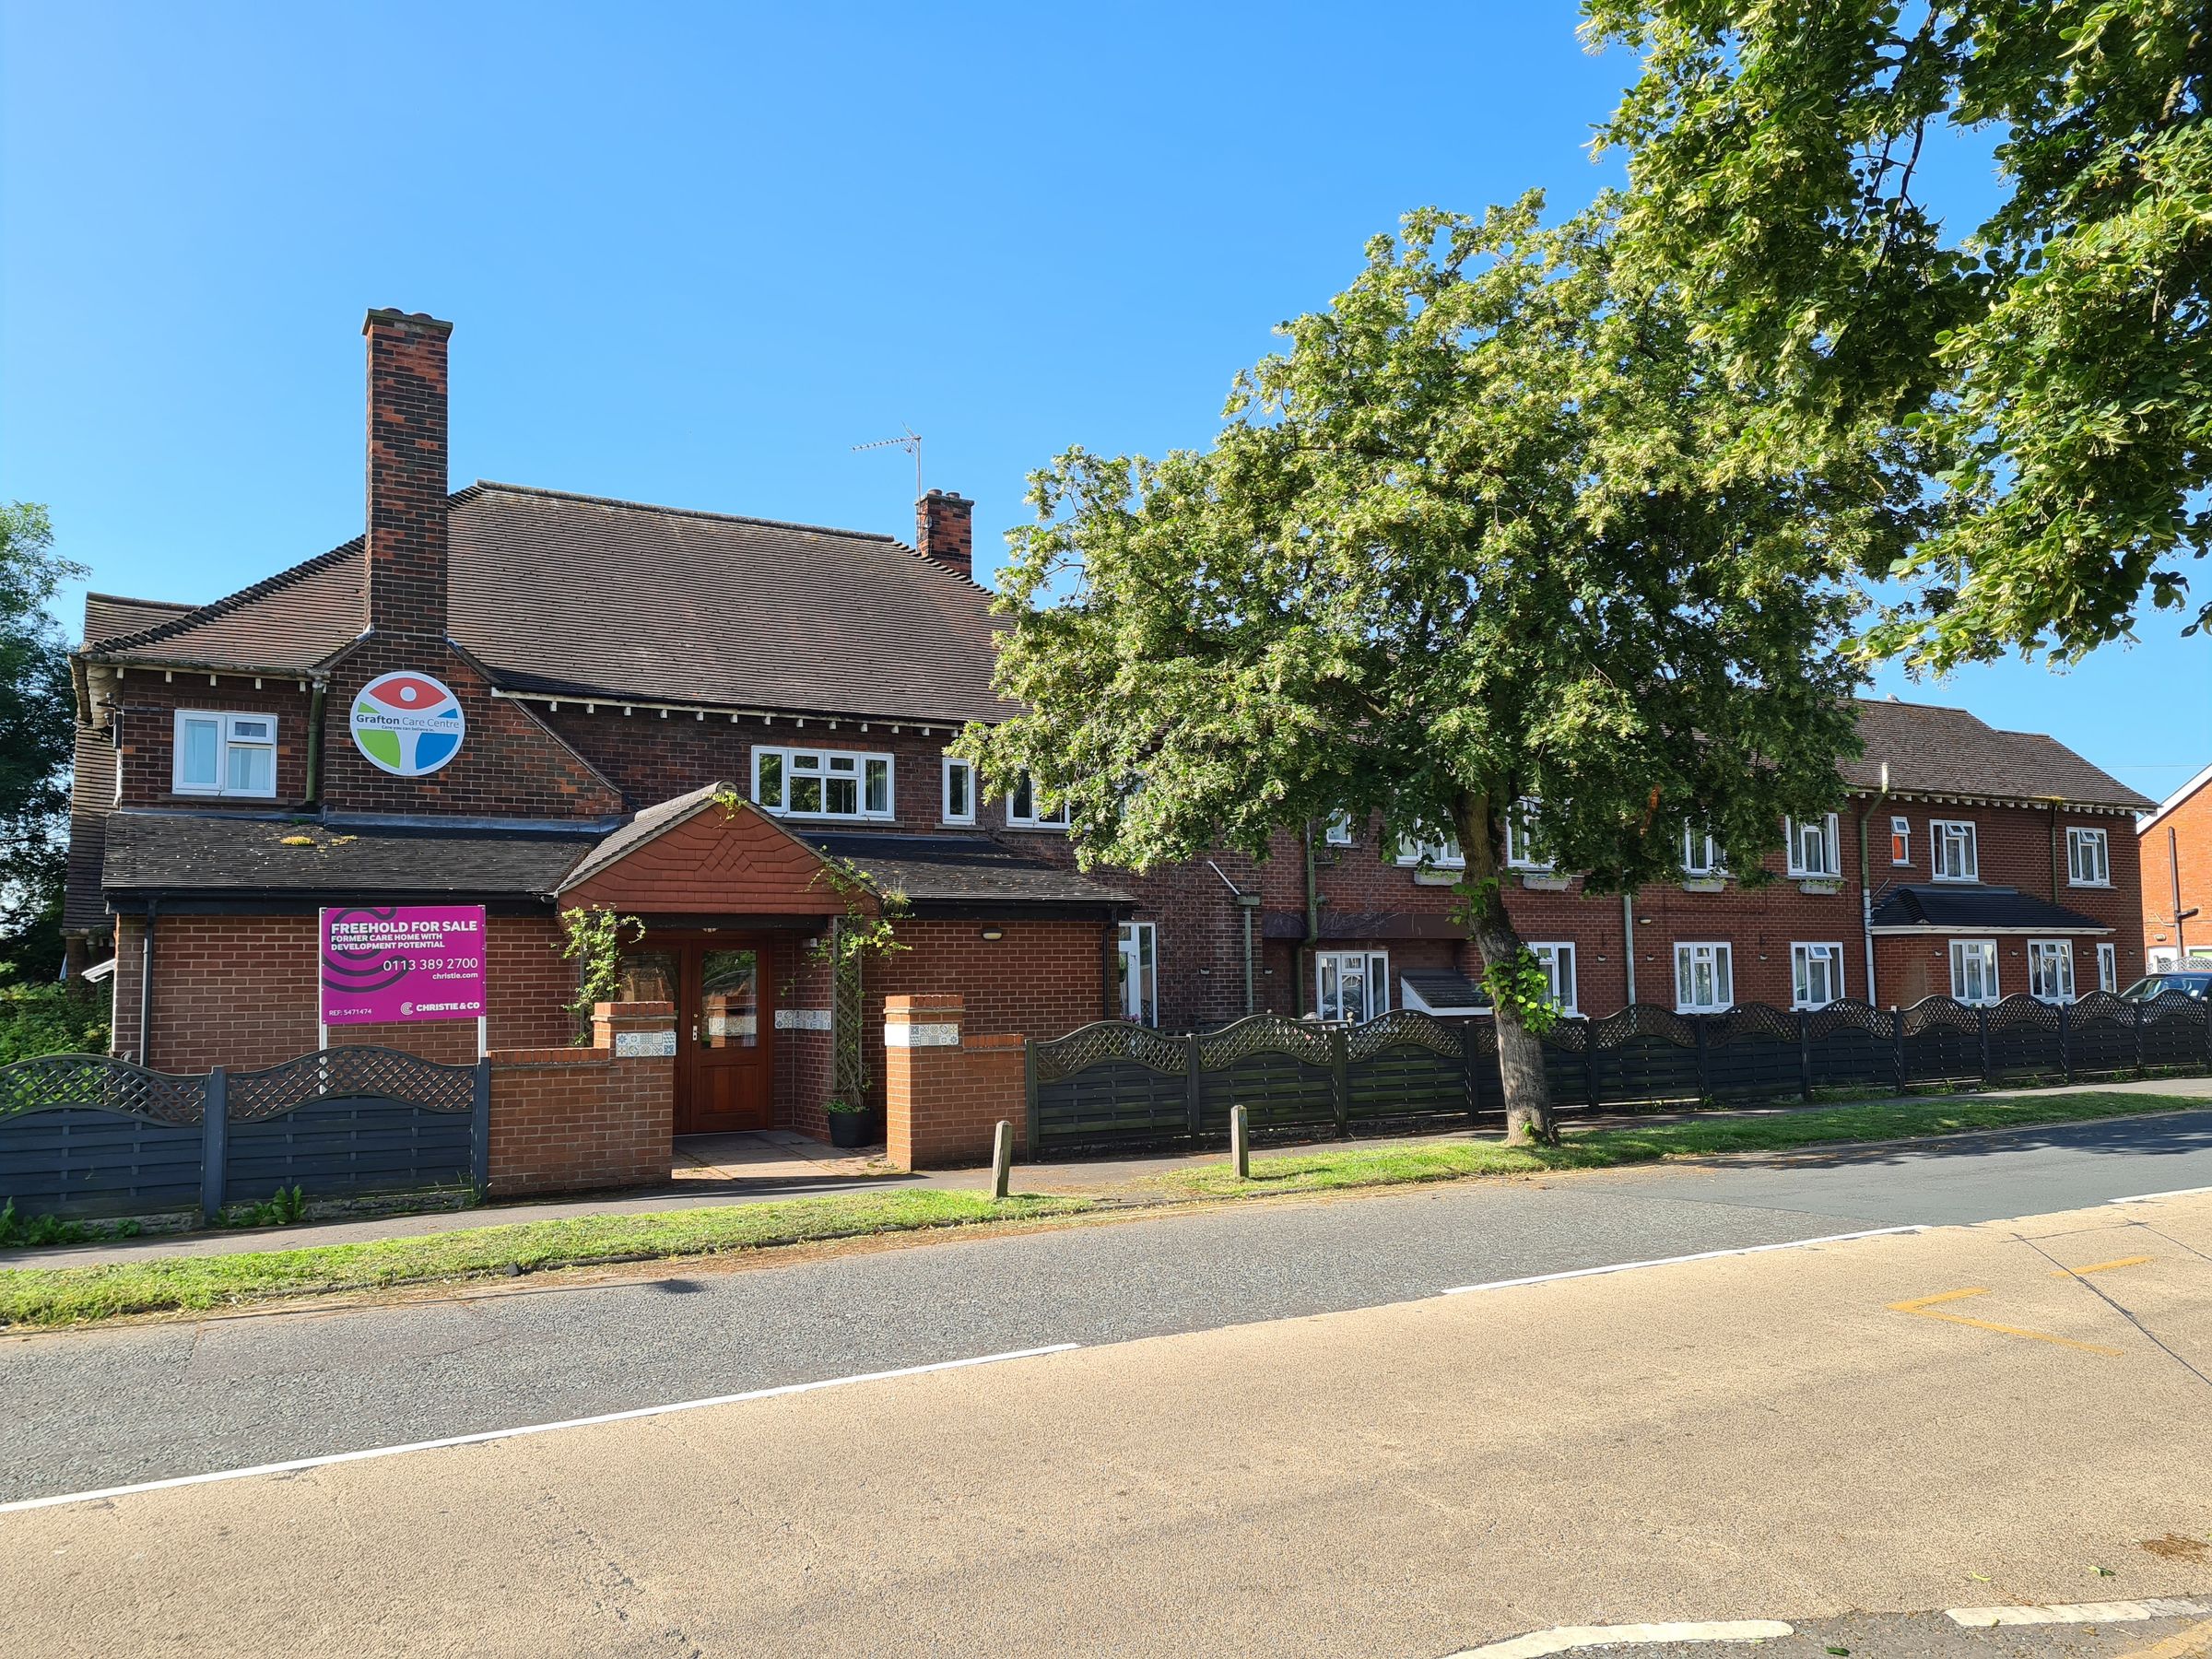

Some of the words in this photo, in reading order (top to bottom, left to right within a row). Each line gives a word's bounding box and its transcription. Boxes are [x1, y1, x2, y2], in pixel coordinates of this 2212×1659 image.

[356, 714, 400, 724] Grafton
[402, 717, 425, 726] Care
[427, 719, 460, 729] Centre
[331, 922, 408, 935] FREEHOLD
[411, 922, 440, 933] FOR
[441, 921, 477, 932] SALE
[331, 935, 369, 943] FORMER
[369, 934, 394, 942] CARE
[331, 942, 397, 951] DEVELOPMENT
[397, 941, 445, 949] POTENTIAL
[382, 959, 417, 971] 0113
[419, 959, 443, 971] 389
[446, 958, 478, 970] 2700
[416, 1003, 459, 1012] CHRISTIE
[459, 1002, 466, 1010] &
[466, 1002, 480, 1010] CO
